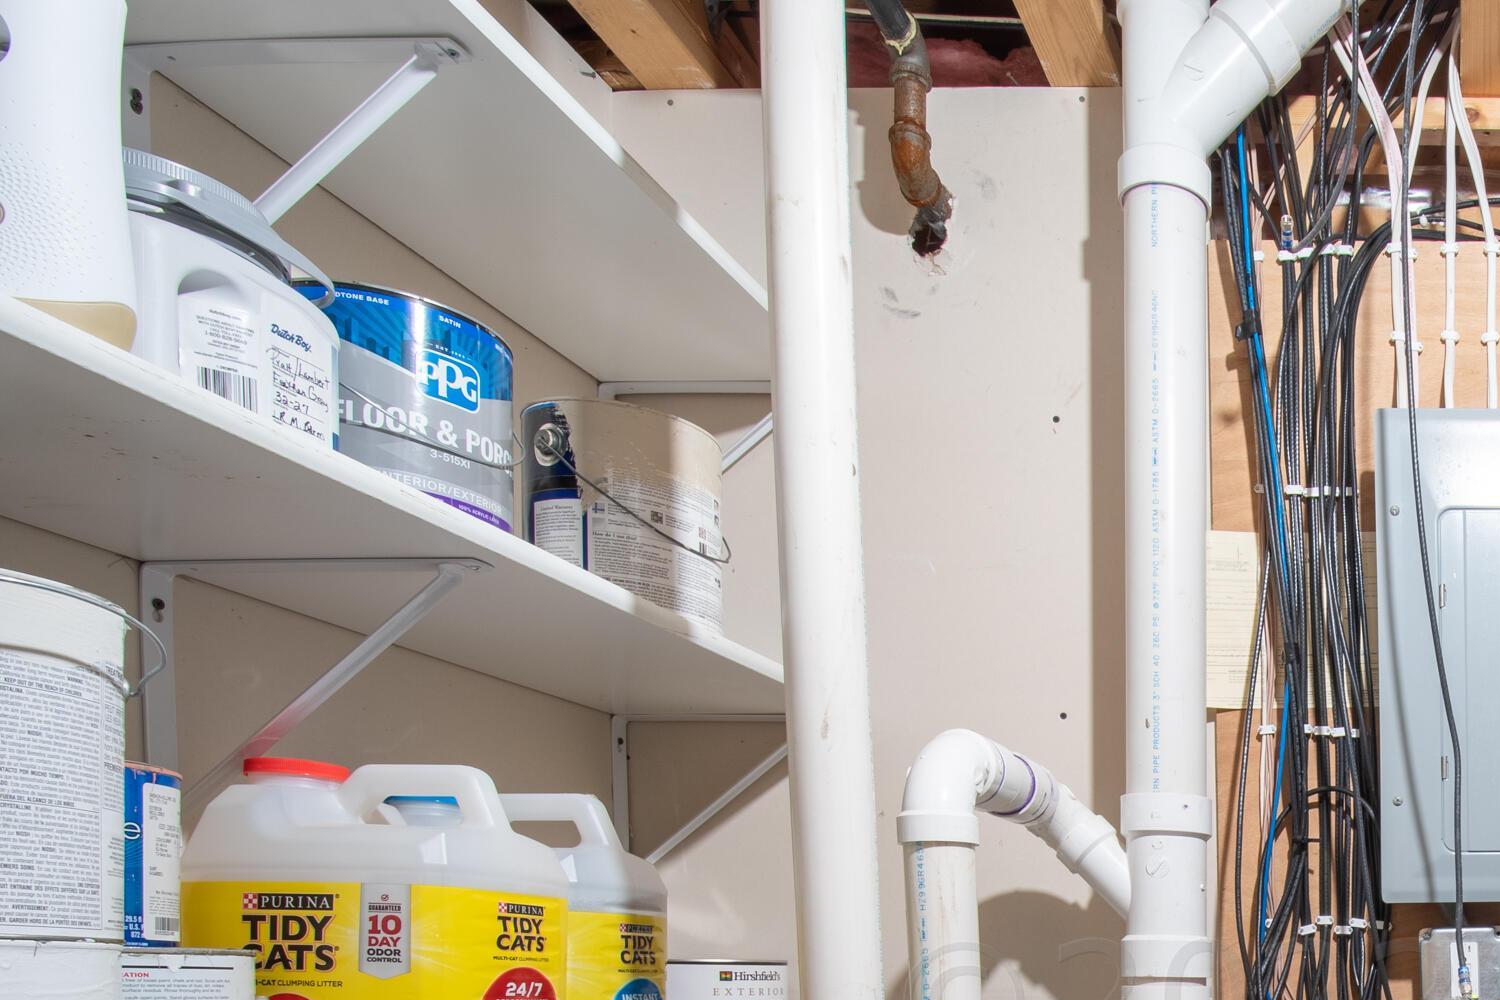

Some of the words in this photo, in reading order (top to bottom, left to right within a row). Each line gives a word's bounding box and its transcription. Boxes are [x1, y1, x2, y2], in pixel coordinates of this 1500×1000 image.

[366, 295, 389, 305] BASE
[438, 315, 461, 328] SATIN
[271, 324, 294, 345] Dutch
[416, 359, 477, 403] PPG
[339, 400, 428, 435] FLOOR
[437, 420, 459, 448] &
[1152, 418, 1160, 443] ASTM
[1152, 509, 1160, 533] ASTM
[1152, 704, 1160, 750] PRODUCTS
[1152, 754, 1160, 774] PIPE
[261, 896, 330, 909] PURINA
[509, 905, 543, 915] PURINA
[242, 915, 333, 941] TIDY
[368, 915, 402, 935] 10
[497, 916, 543, 934] TIDY
[368, 936, 401, 947] DAY
[497, 934, 544, 952] CATS
[621, 935, 653, 949] TIDY
[242, 944, 334, 971] CATS
[621, 951, 655, 964] CATS
[506, 982, 543, 997] 24/7
